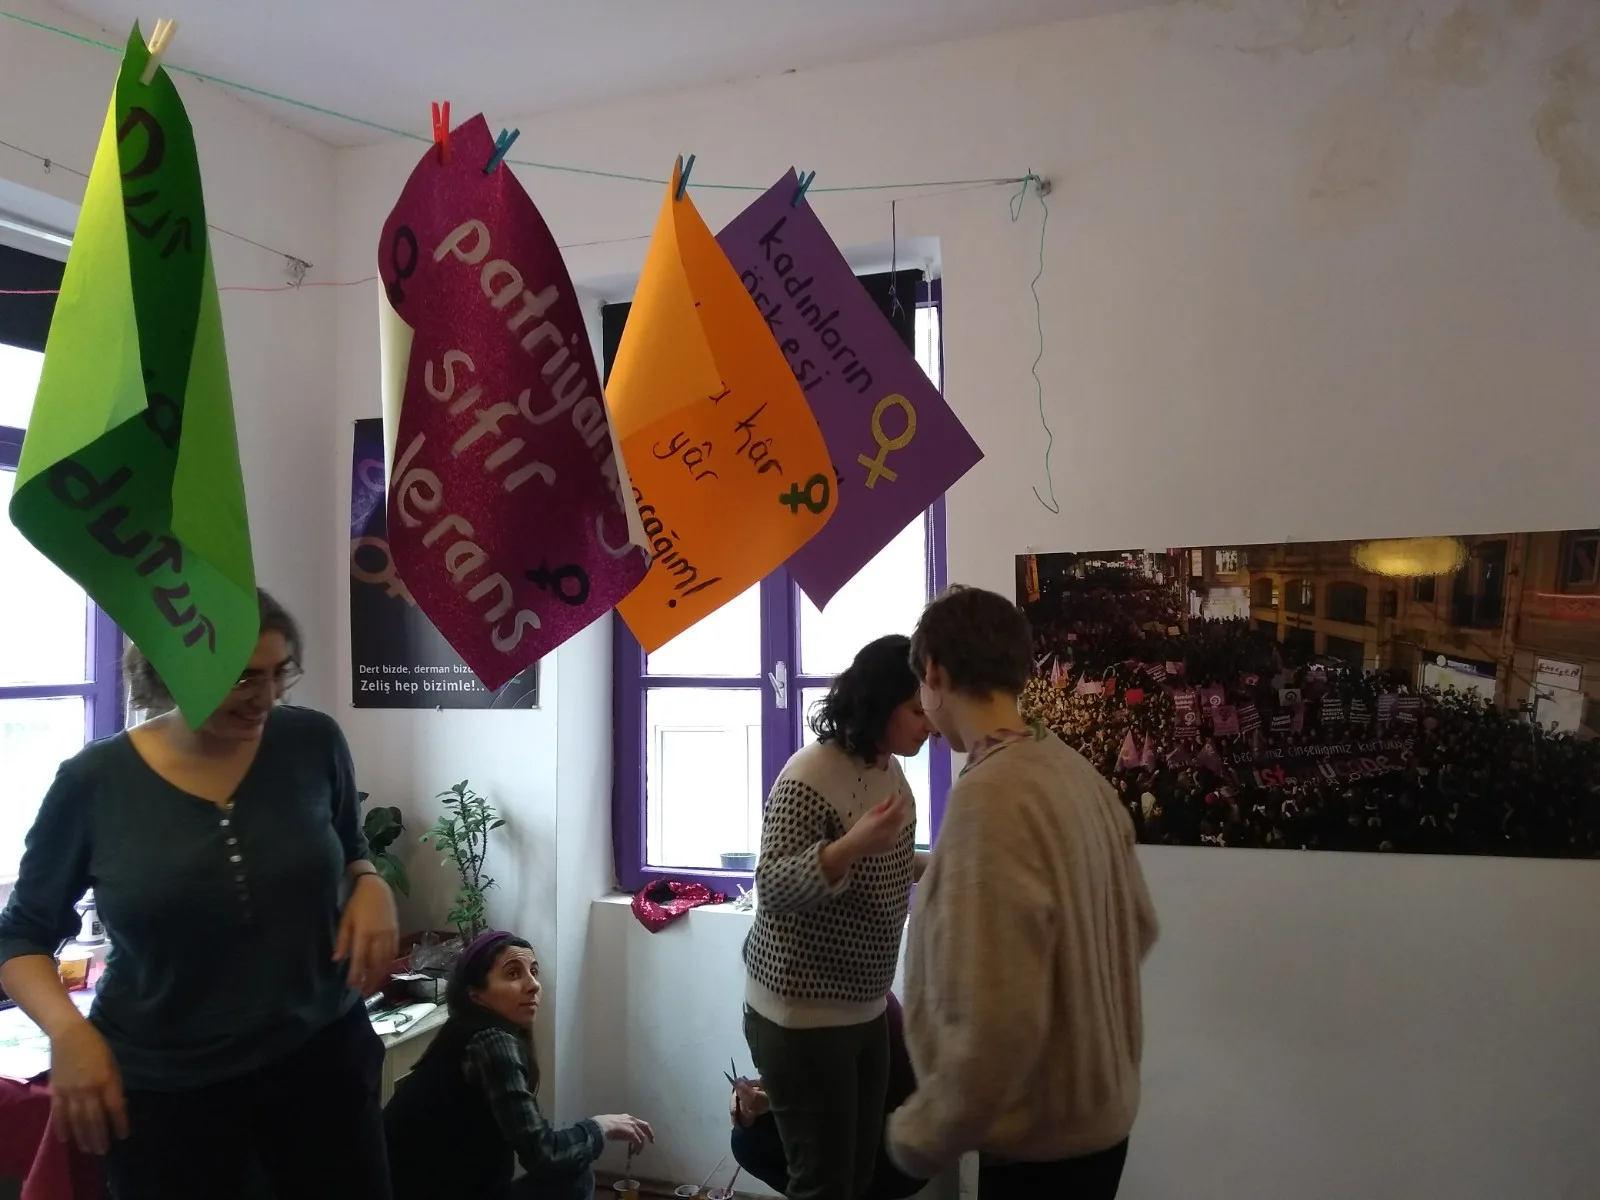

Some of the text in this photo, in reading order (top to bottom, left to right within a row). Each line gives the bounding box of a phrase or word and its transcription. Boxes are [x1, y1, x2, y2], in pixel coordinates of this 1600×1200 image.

[424, 349, 556, 496] sıfır
[394, 432, 542, 654] lerans
[359, 664, 380, 674] Dert
[382, 664, 411, 675] bizde,
[414, 664, 450, 674] derman
[360, 679, 390, 694] Zeliş
[395, 680, 419, 694] hep
